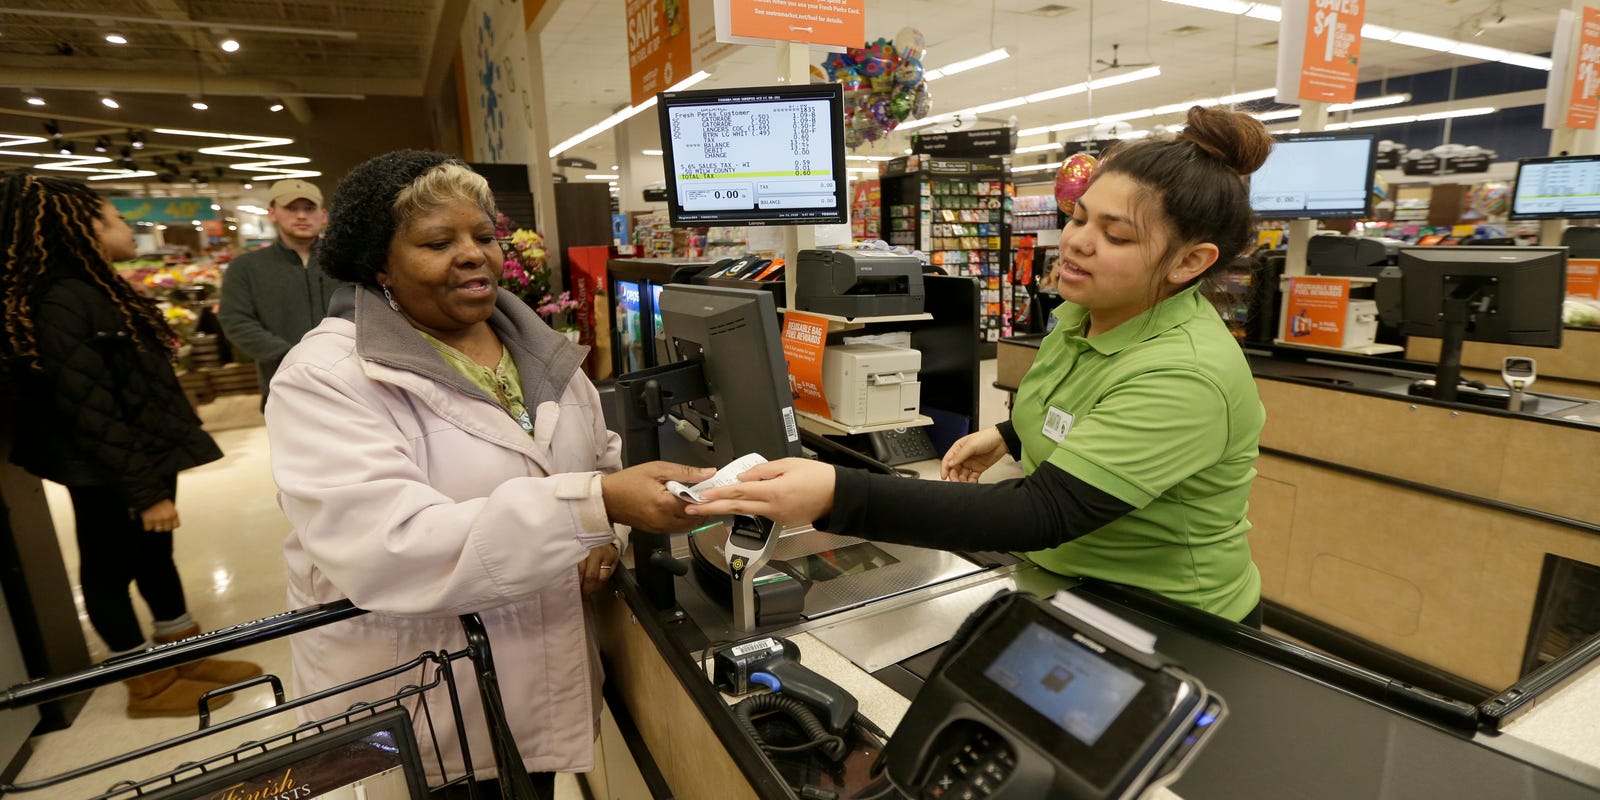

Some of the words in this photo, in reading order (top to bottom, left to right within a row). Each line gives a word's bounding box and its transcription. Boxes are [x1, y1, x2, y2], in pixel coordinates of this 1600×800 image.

[629, 1, 660, 52] SAVE
[1313, 9, 1338, 62] $1
[952, 114, 963, 128] 3
[714, 190, 739, 200] 0.00
[626, 288, 639, 305] peps
[811, 326, 823, 336] BAG
